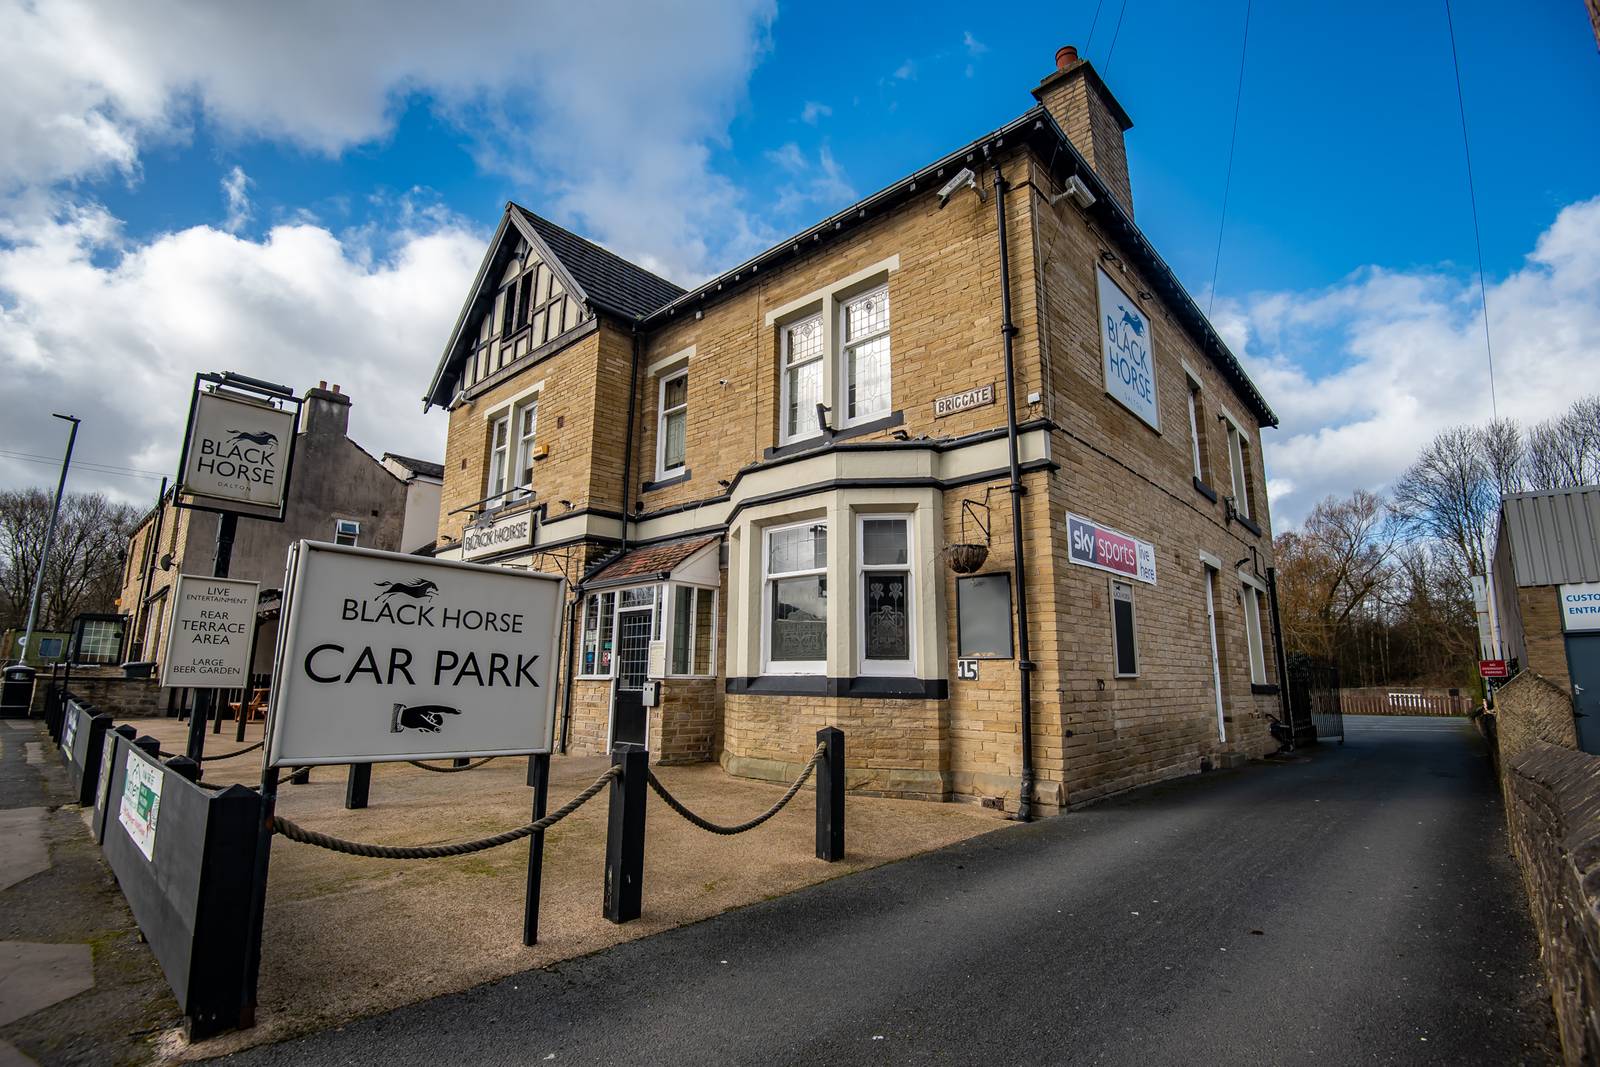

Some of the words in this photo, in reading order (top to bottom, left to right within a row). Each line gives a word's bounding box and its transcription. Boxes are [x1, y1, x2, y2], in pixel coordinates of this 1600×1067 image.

[1107, 314, 1149, 375] BLACK
[1109, 345, 1152, 405] HORSE
[201, 438, 275, 467] BLACK
[197, 456, 275, 485] HORSE
[217, 481, 251, 492] DALTON
[494, 521, 528, 544] HORSE
[1073, 525, 1095, 559] sky
[1098, 538, 1135, 566] sports
[1138, 543, 1150, 562] live
[1140, 565, 1155, 581] here
[186, 593, 249, 604] ENTERTAINMENT
[207, 586, 231, 597] LIVE
[200, 610, 229, 620] REAR
[342, 598, 435, 628] BLACK
[442, 607, 524, 634] HORSE
[181, 619, 246, 634] TERRACE
[191, 633, 230, 645] AREA
[173, 665, 197, 674] BEER
[199, 666, 241, 675] GARDEN
[192, 658, 224, 667] LARGE
[304, 643, 416, 686] CAR
[434, 650, 540, 688] PARK
[958, 660, 978, 680] 15
